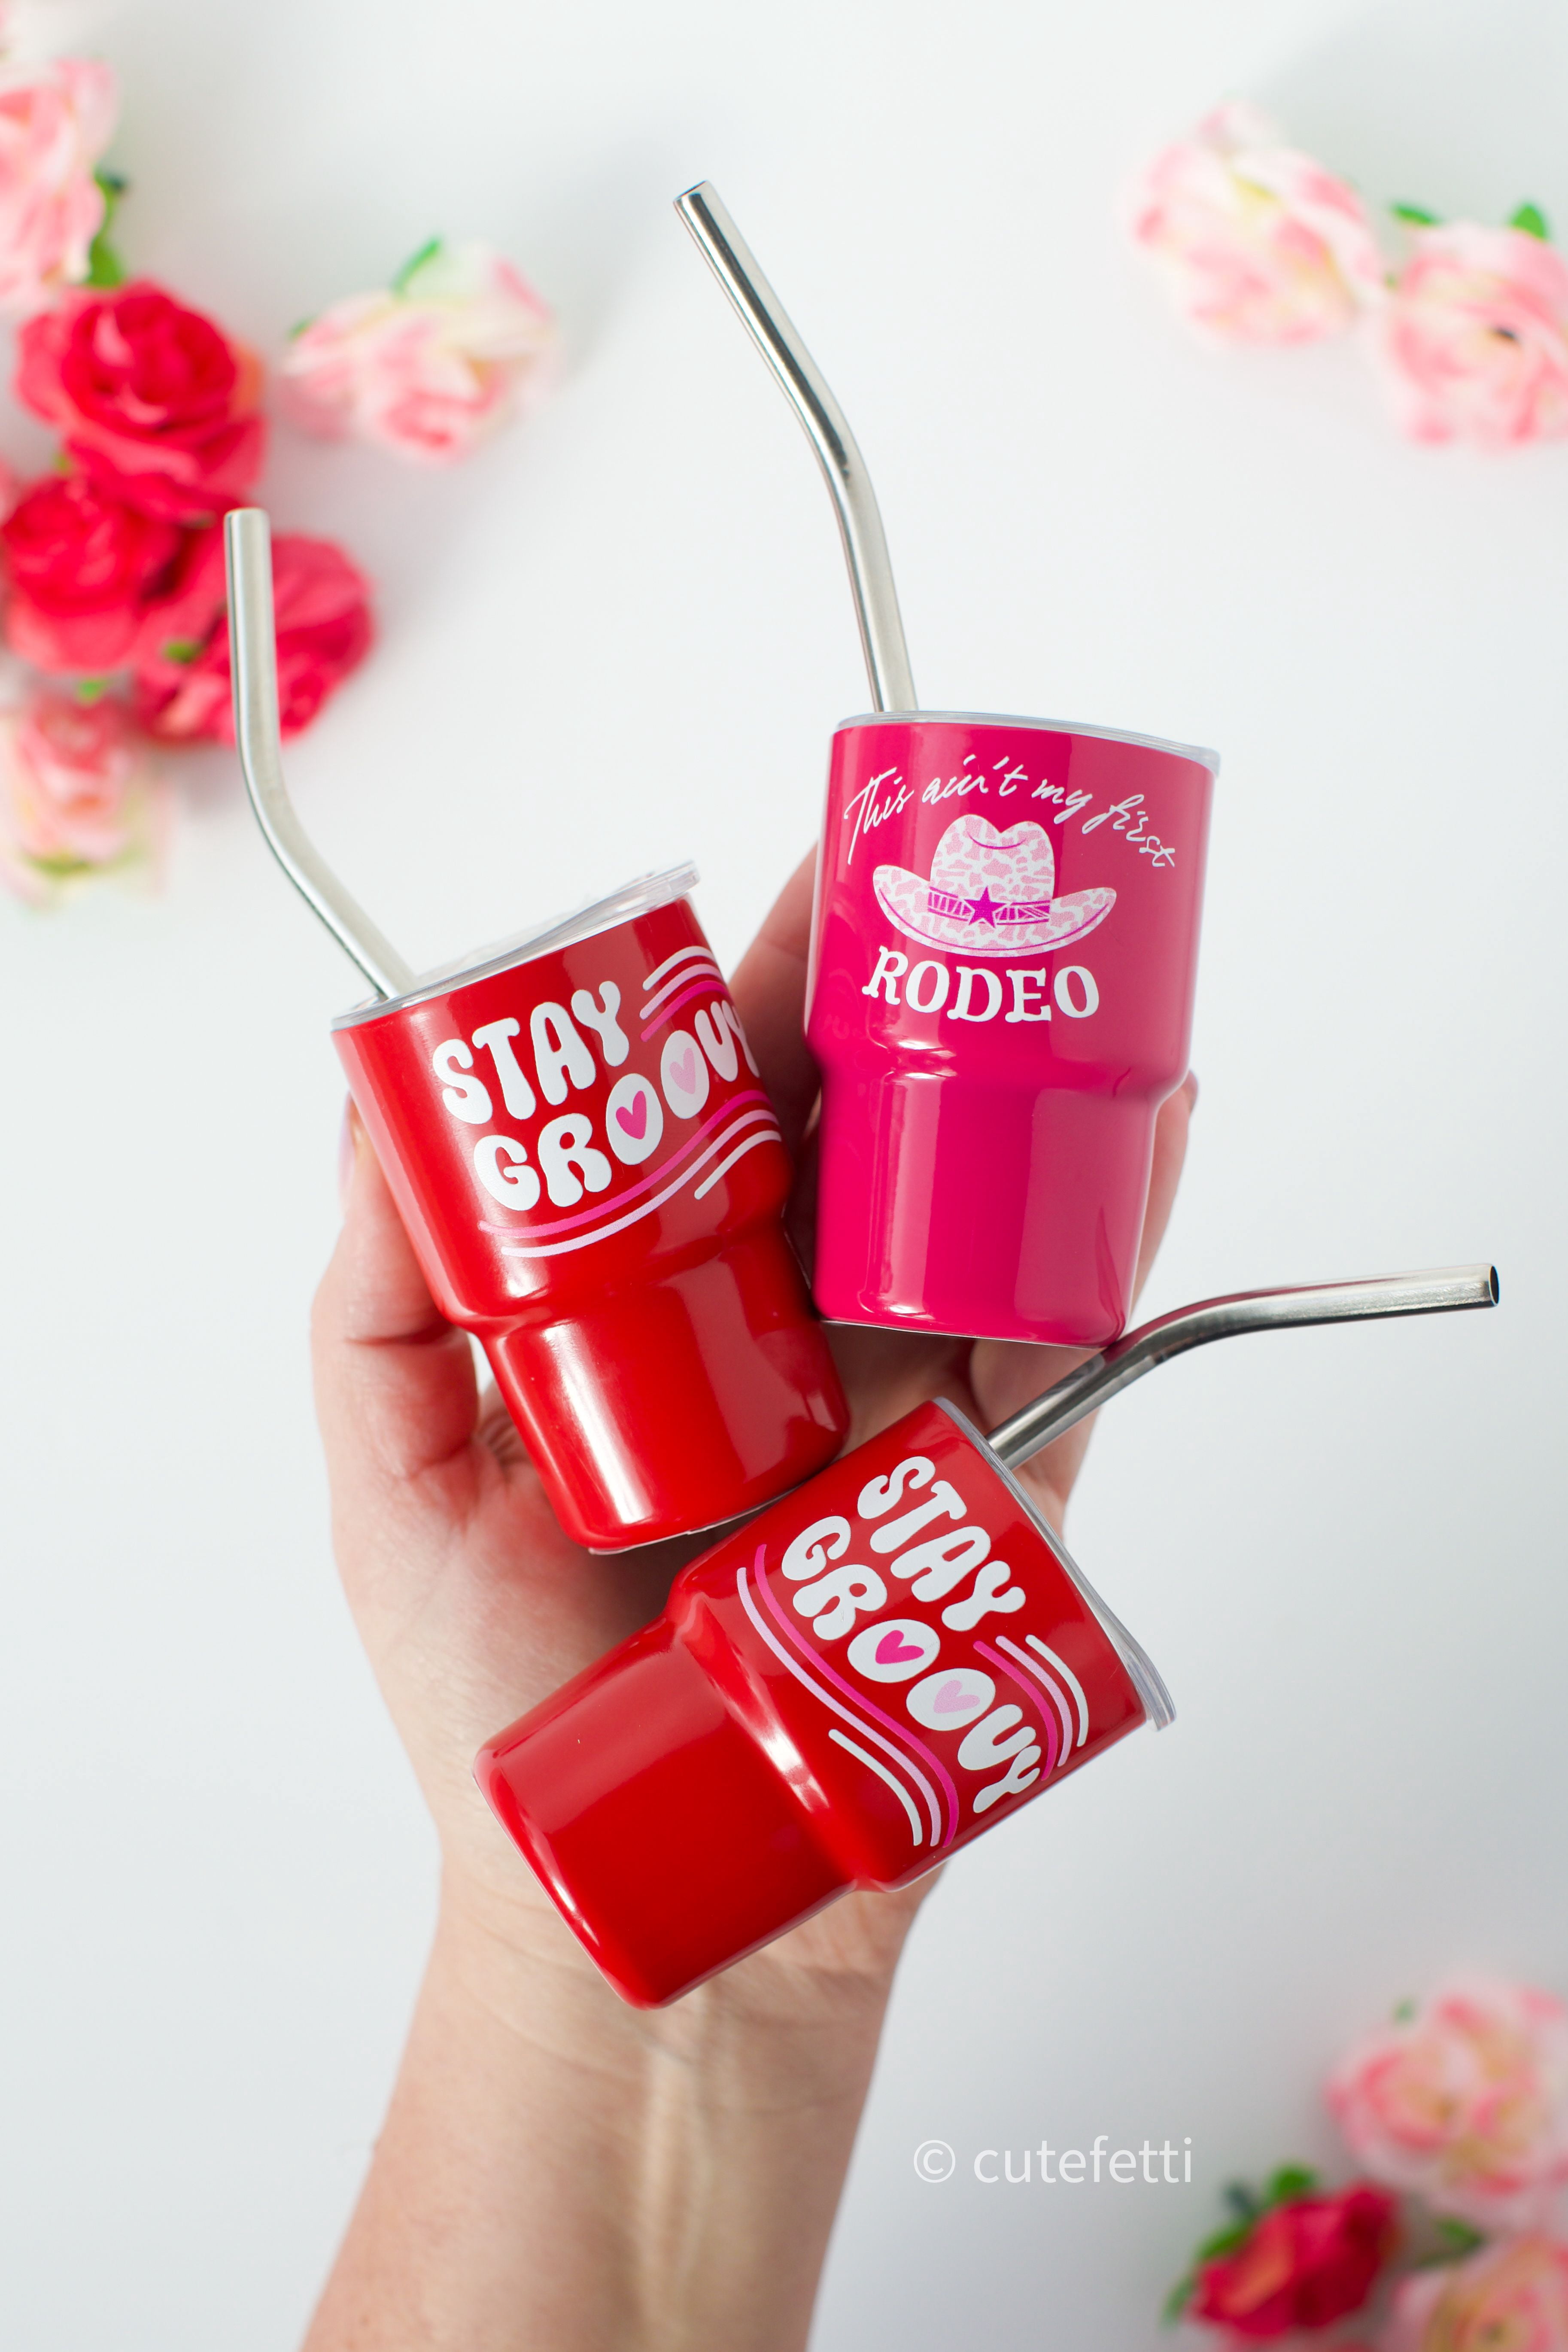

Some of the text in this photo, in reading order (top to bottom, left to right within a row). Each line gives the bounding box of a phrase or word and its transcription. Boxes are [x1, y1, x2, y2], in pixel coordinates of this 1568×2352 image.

[844, 754, 1176, 868] This ain't my first
[432, 980, 629, 1124] STAY
[862, 945, 1100, 1023] RODEO
[857, 1456, 1026, 1632] STAY
[781, 1515, 1042, 1814] GROOVY
